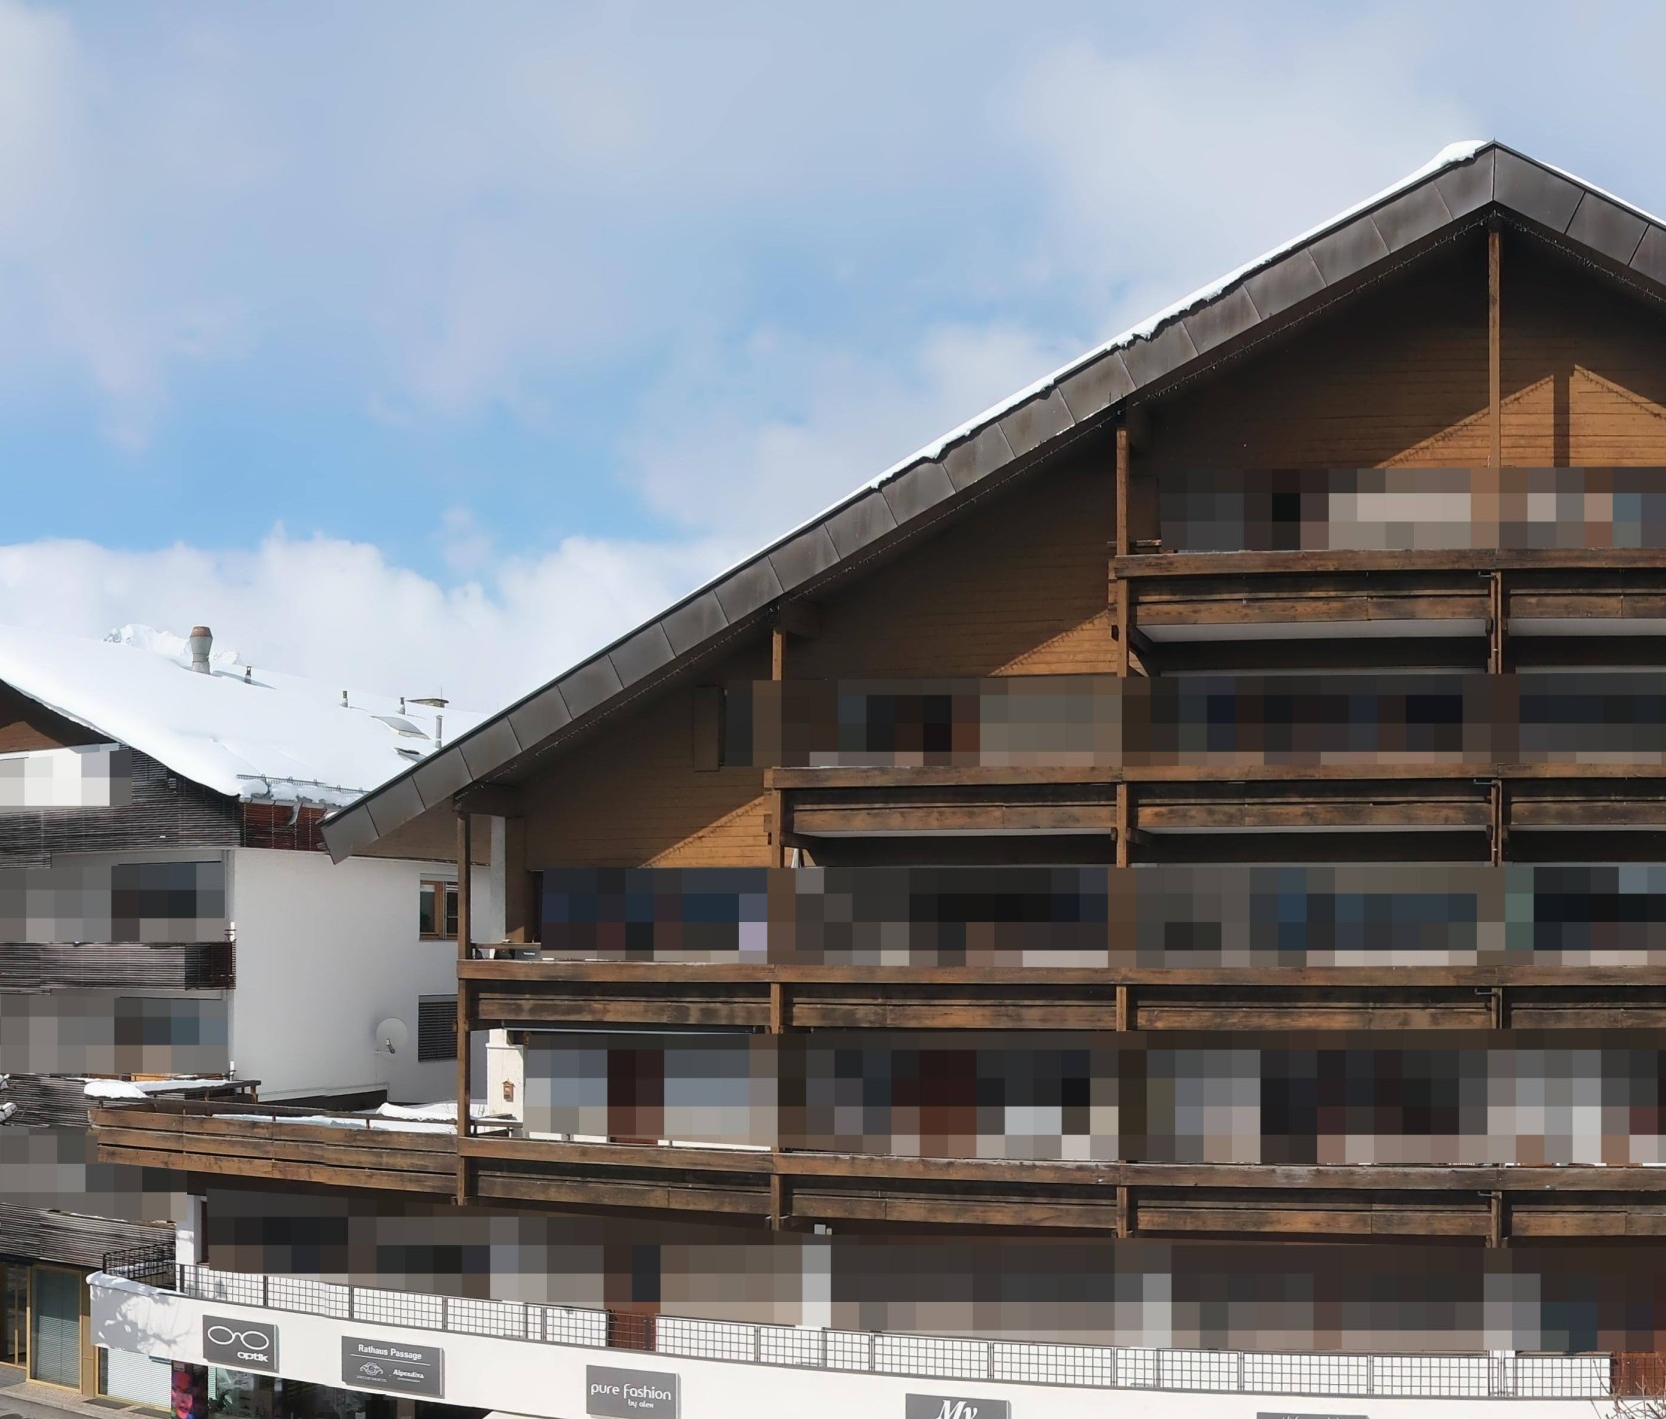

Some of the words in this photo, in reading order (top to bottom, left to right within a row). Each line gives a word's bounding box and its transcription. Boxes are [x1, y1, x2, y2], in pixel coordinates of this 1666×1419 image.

[237, 1350, 269, 1363] optik
[358, 1344, 389, 1356] Rathaus
[390, 1348, 422, 1361] Passage
[591, 1383, 621, 1396] pure
[628, 1399, 637, 1408] by
[639, 1401, 654, 1409] alex
